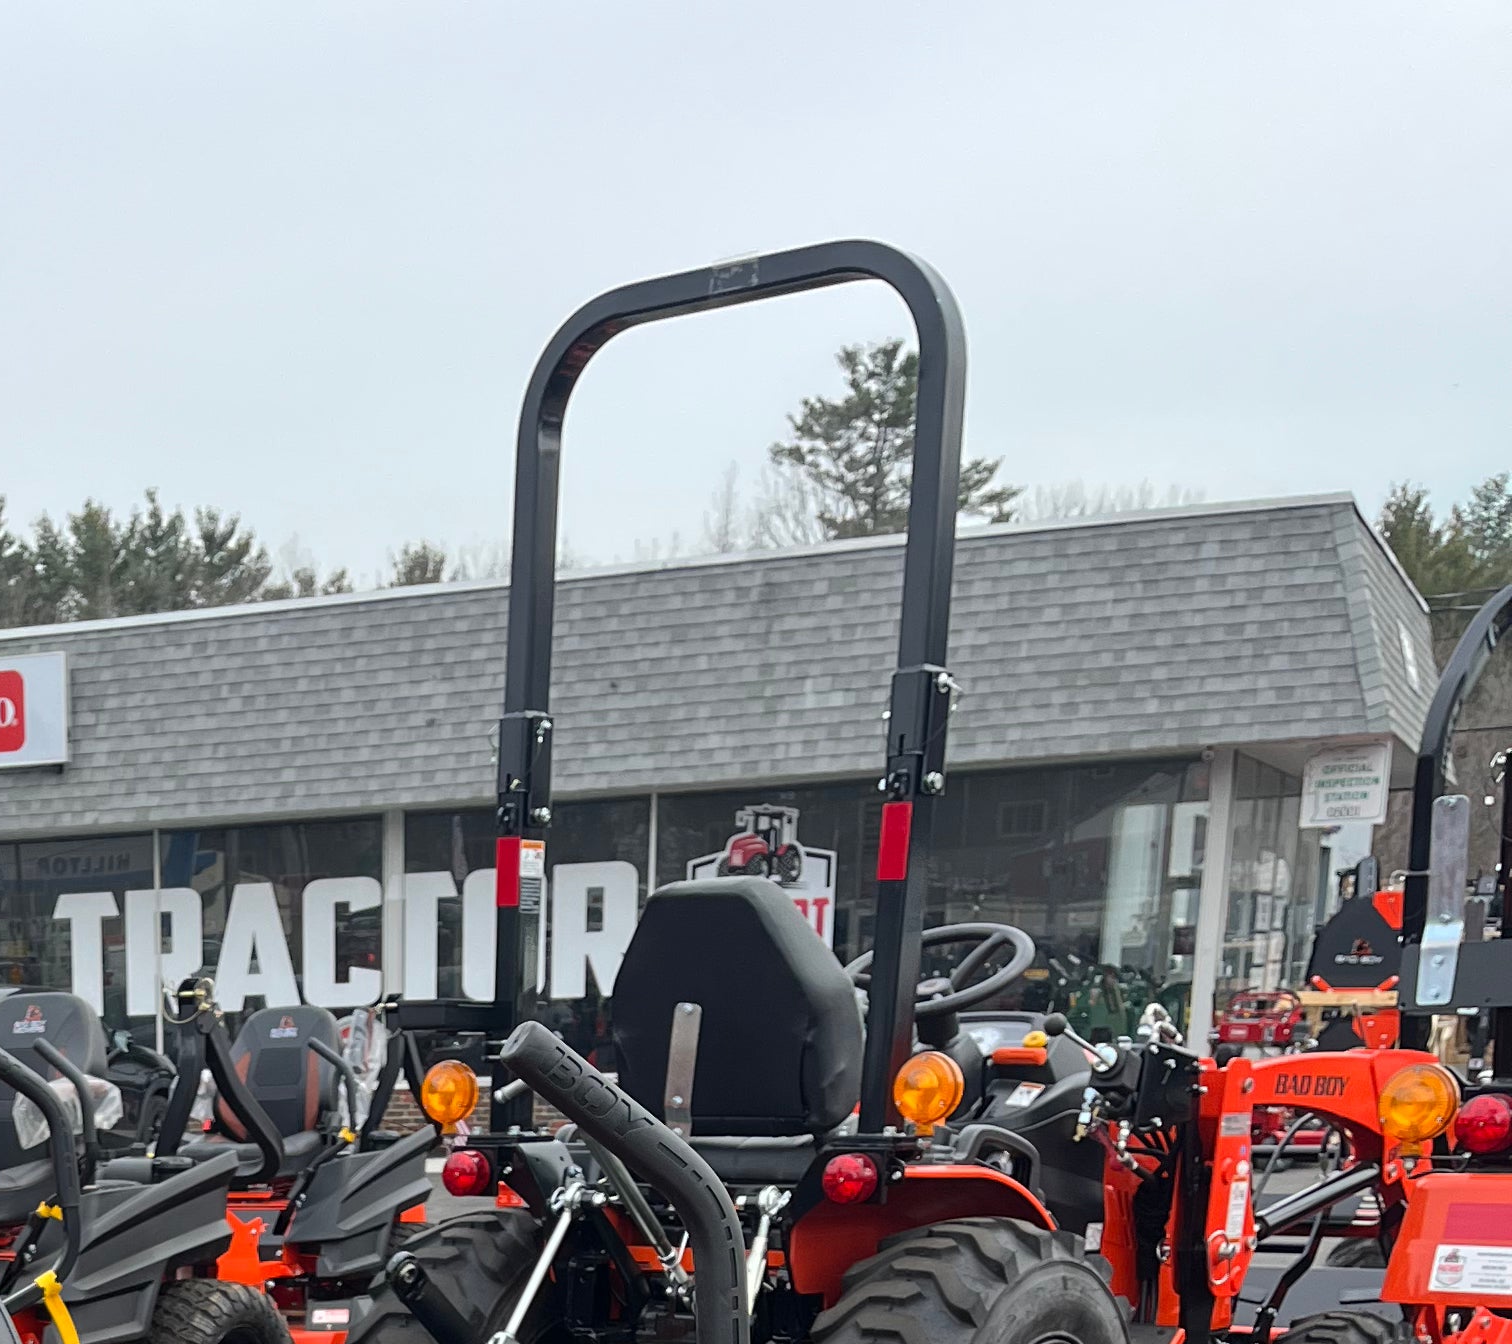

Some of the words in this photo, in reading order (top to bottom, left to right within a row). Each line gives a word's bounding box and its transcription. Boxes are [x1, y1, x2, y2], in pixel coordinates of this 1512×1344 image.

[52, 860, 640, 1017] TRACTOR
[1275, 1074, 1311, 1096] BAD
[1313, 1075, 1350, 1096] BOY
